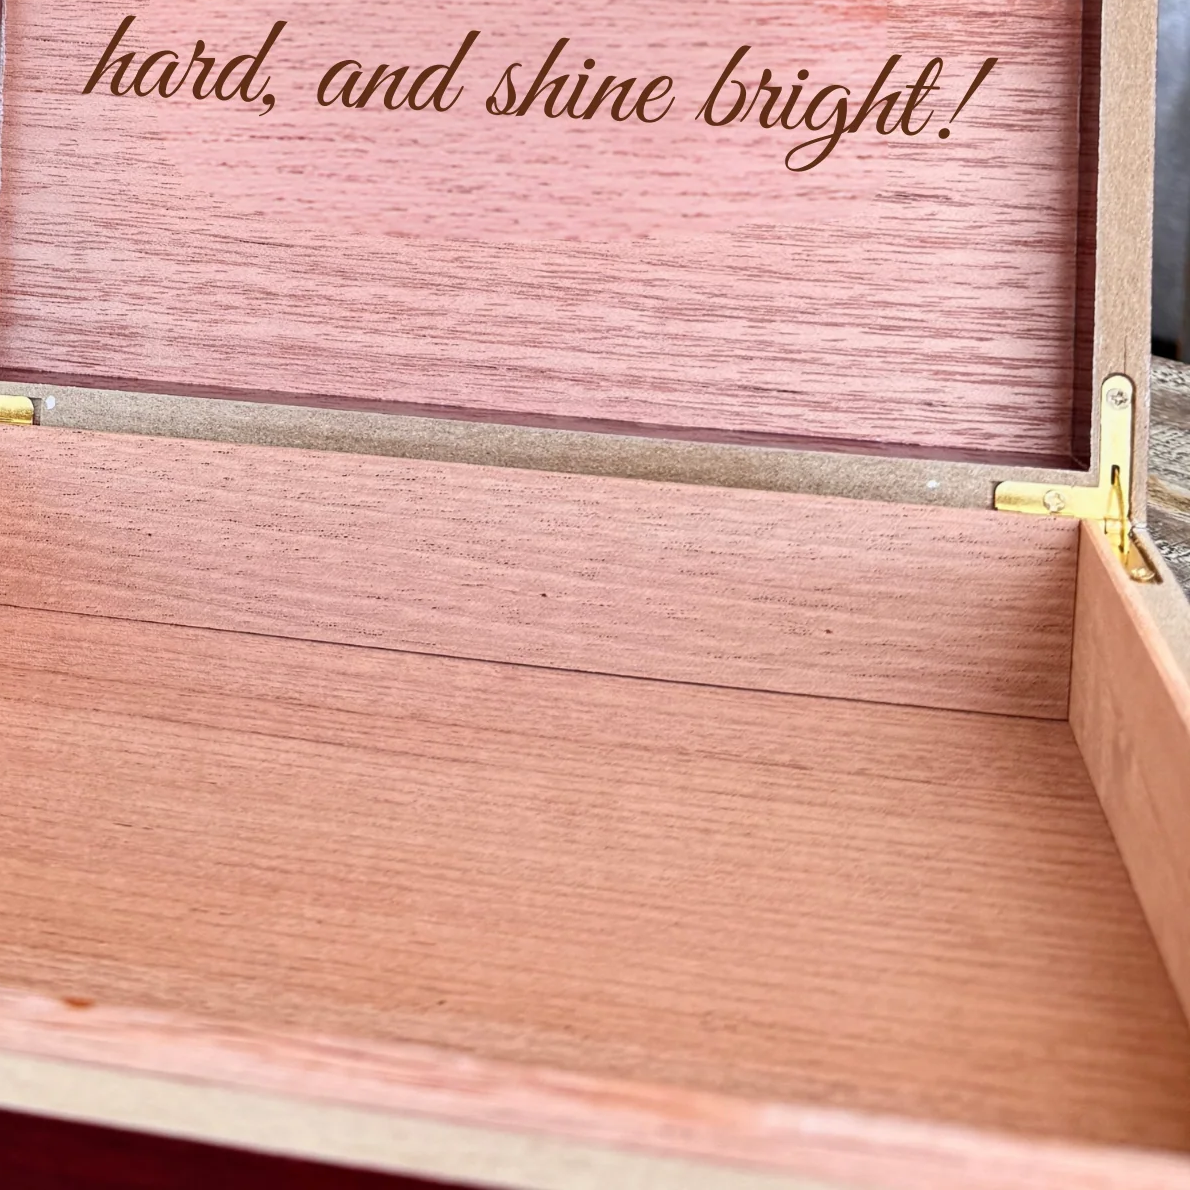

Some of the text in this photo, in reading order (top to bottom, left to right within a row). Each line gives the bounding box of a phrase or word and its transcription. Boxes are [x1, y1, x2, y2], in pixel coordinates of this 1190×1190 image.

[81, 15, 999, 172] hard, and shine bright!
